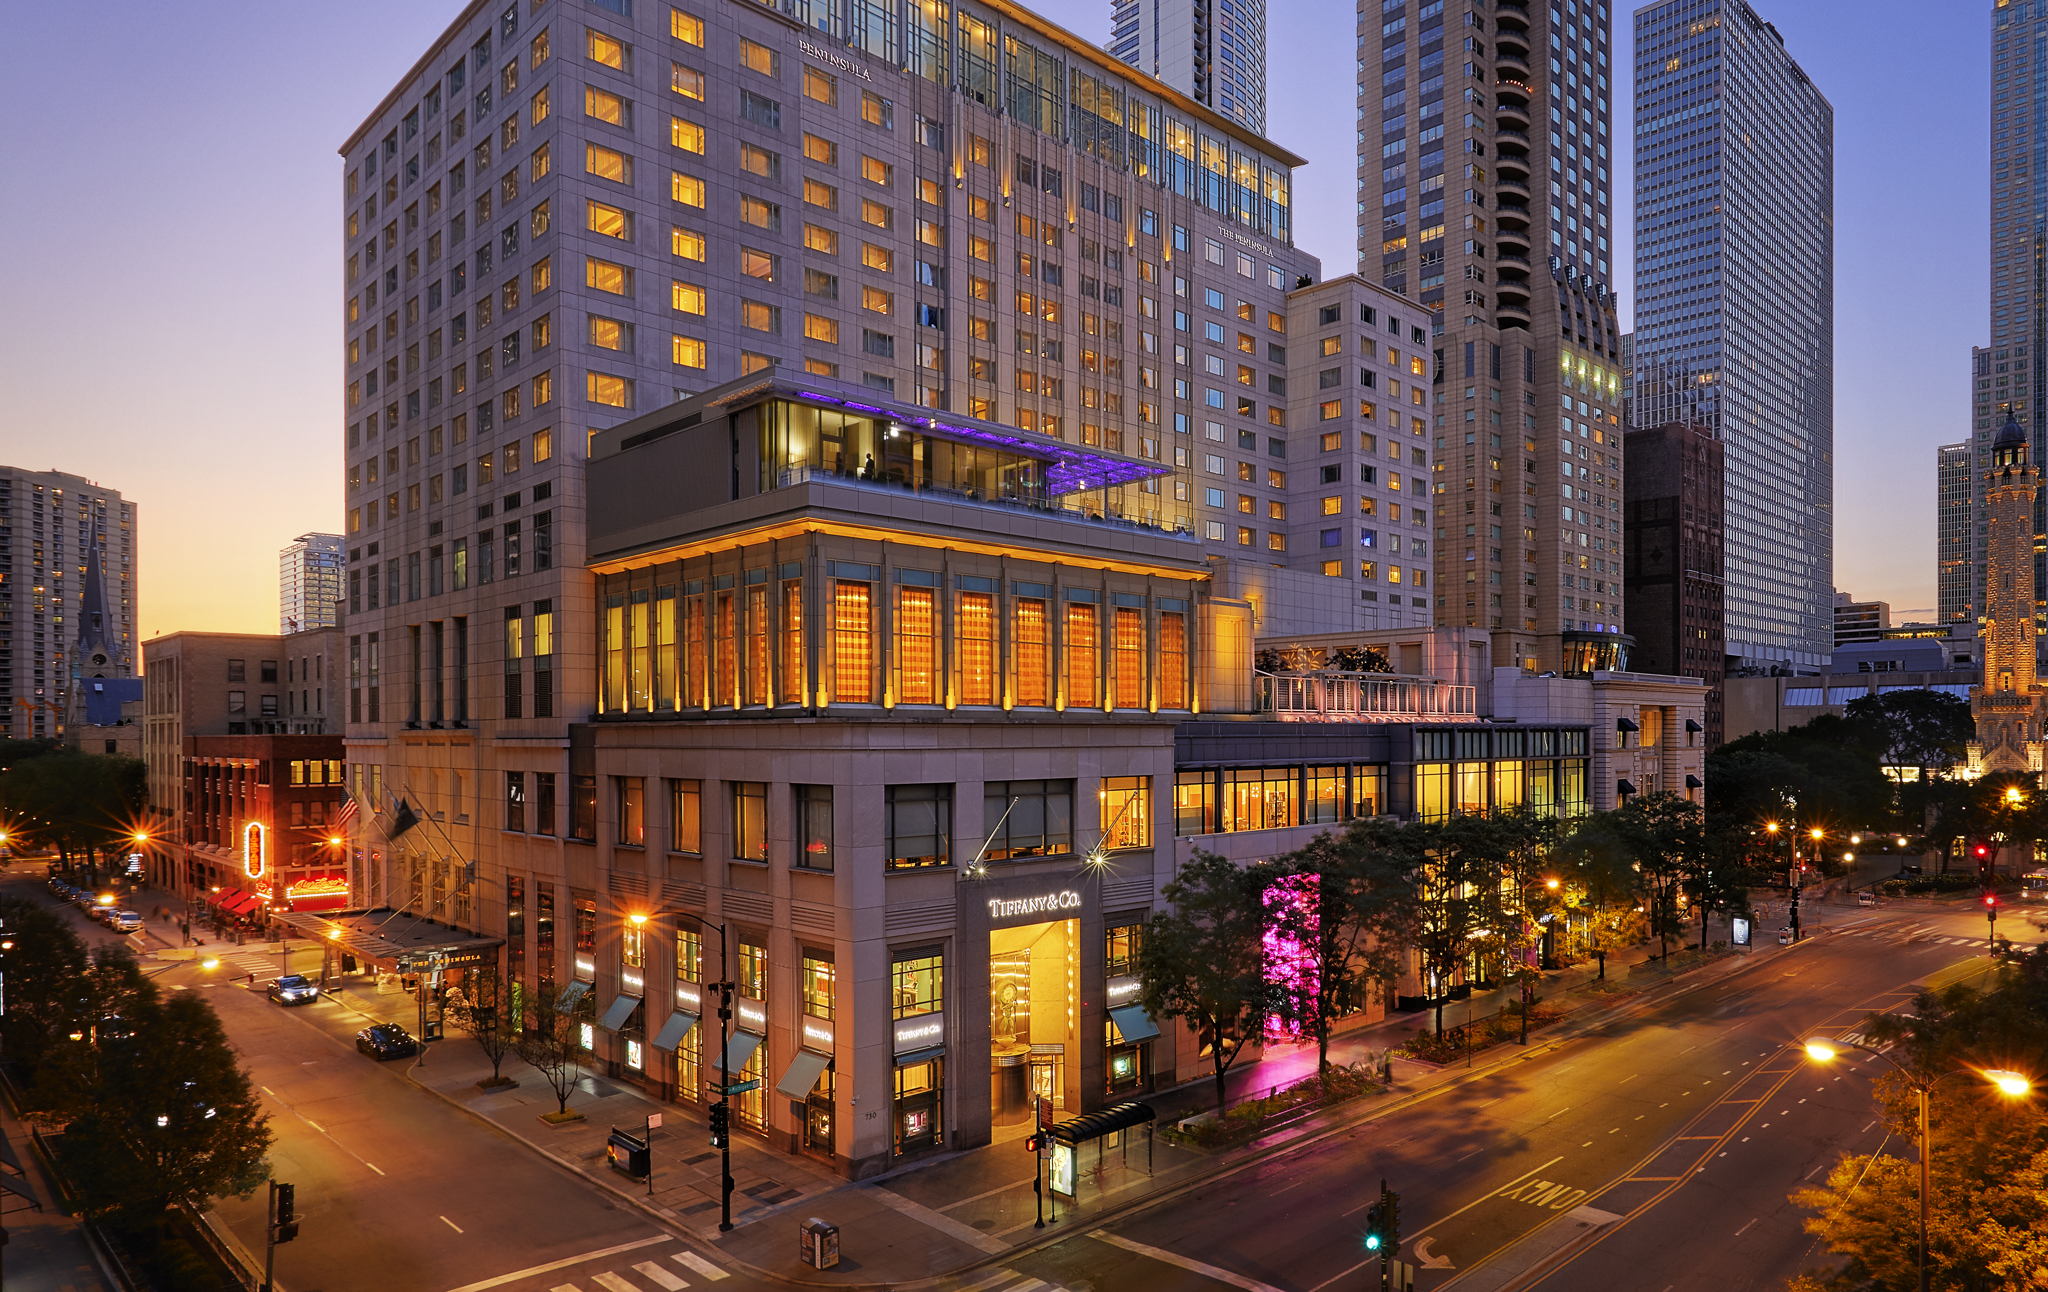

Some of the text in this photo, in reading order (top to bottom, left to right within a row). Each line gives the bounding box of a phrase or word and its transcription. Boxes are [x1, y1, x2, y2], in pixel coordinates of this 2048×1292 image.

[798, 39, 872, 82] PENINSULA
[1218, 226, 1274, 258] THE PENINSULA
[434, 954, 481, 965] PENINSULA
[1499, 1178, 1587, 1210] ONLY
